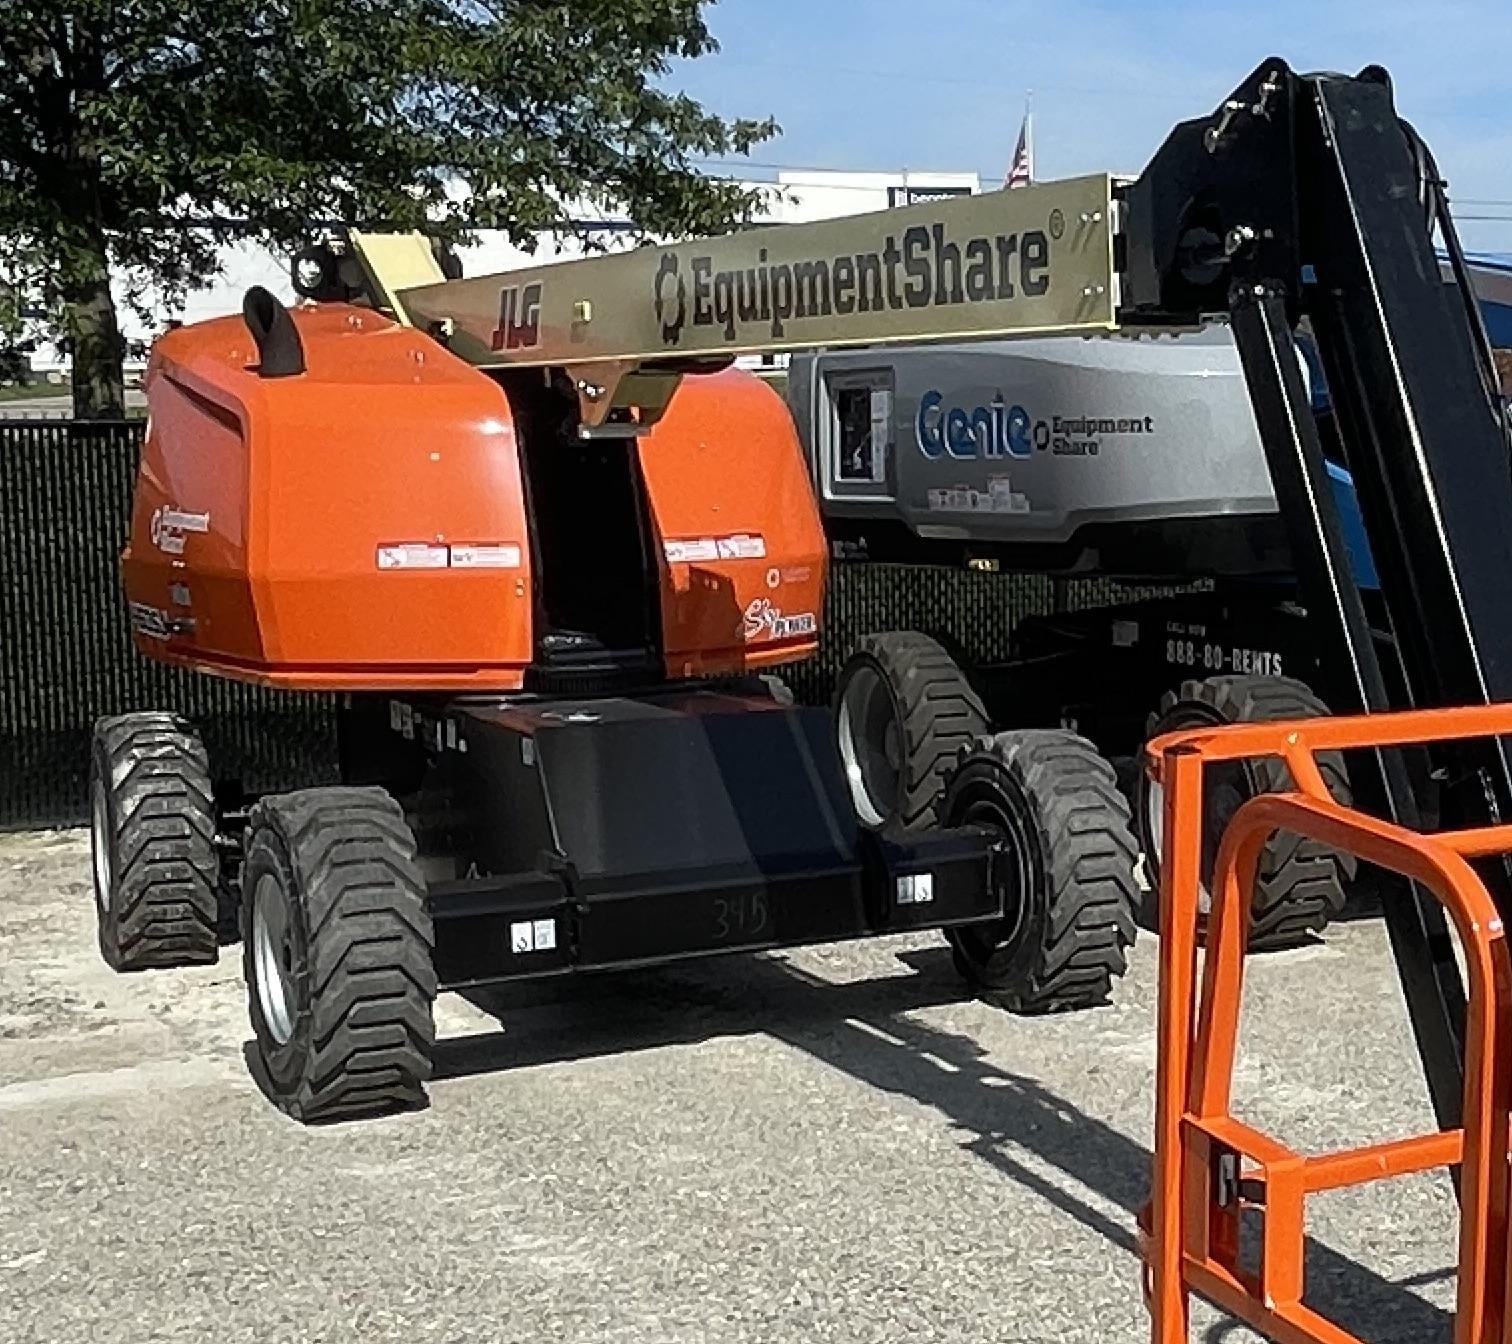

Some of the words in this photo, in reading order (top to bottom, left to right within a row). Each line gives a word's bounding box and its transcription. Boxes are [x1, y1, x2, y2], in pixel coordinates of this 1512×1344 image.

[492, 282, 544, 352] JLG
[915, 388, 1031, 459] Genie
[1052, 416, 1154, 437] Equipment
[1053, 438, 1100, 455] Share
